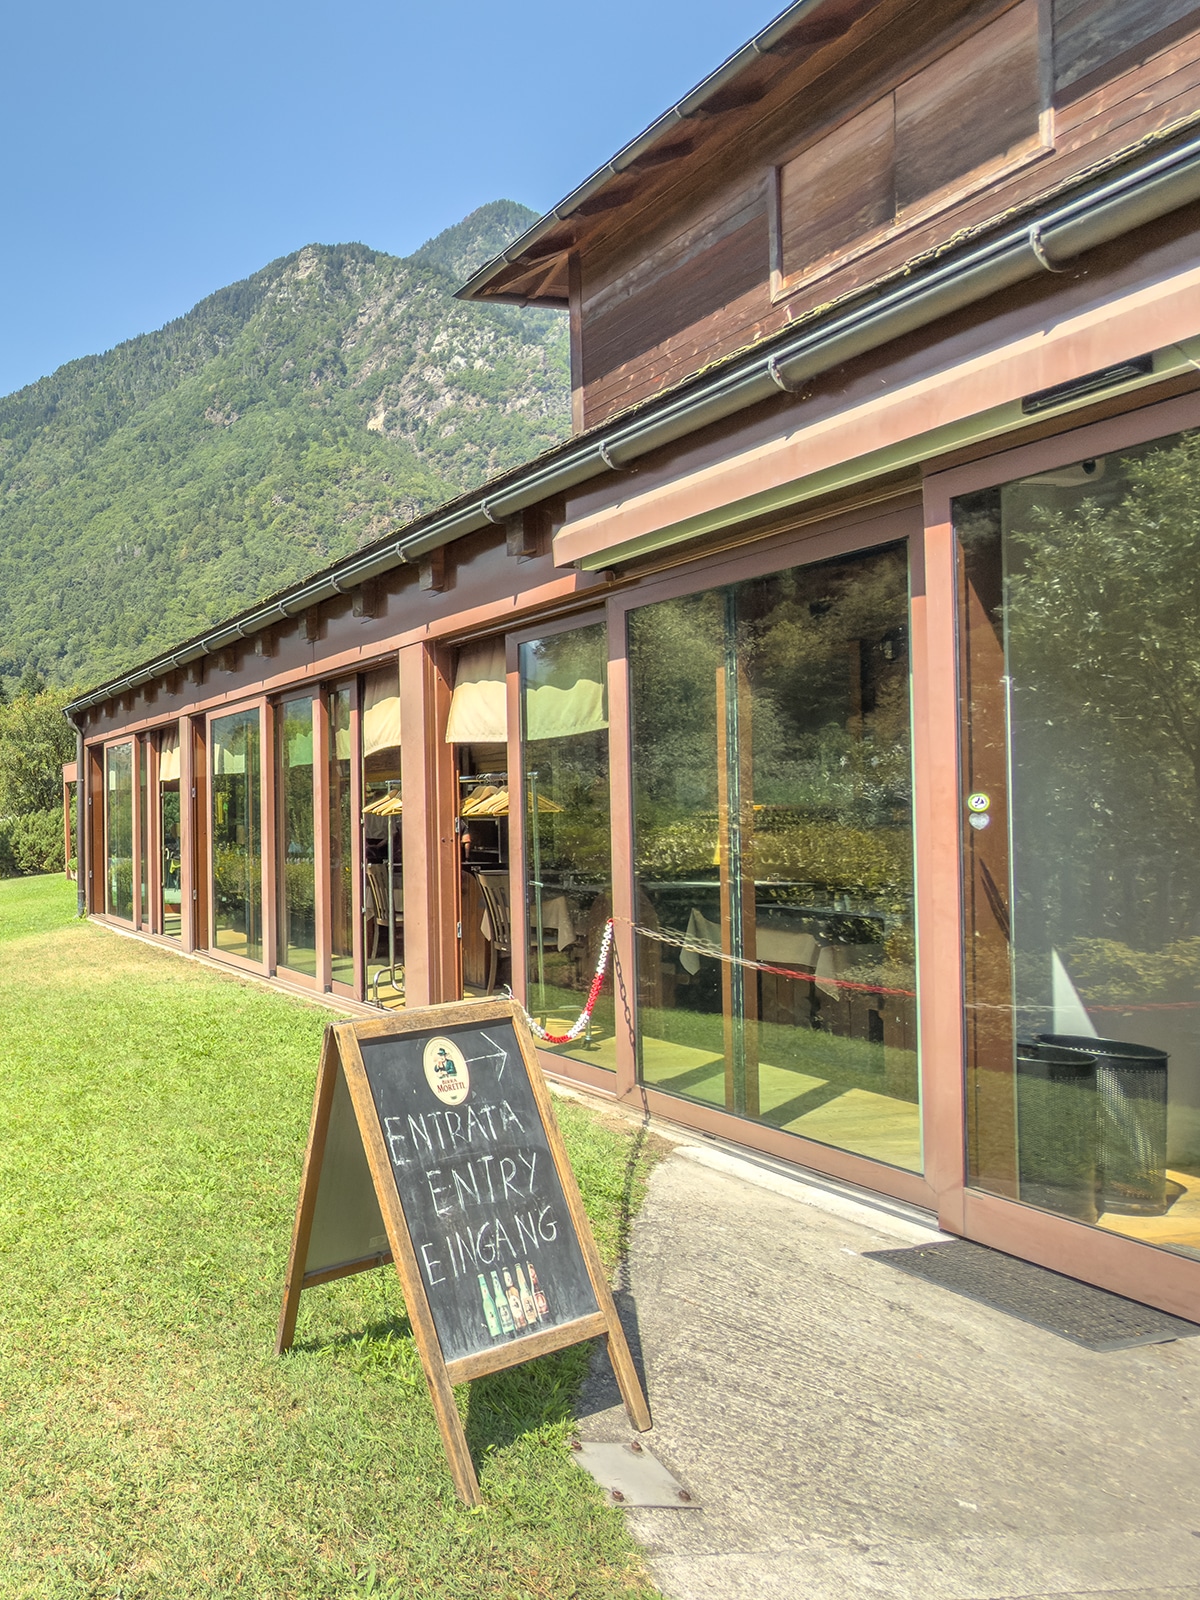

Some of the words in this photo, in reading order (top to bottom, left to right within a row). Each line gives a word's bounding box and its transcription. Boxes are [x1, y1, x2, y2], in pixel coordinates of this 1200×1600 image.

[436, 1081, 466, 1094] MORETTI
[384, 1100, 526, 1167] ENTRATA
[426, 1149, 538, 1218] ENTRY
[420, 1205, 558, 1286] EINGANG
